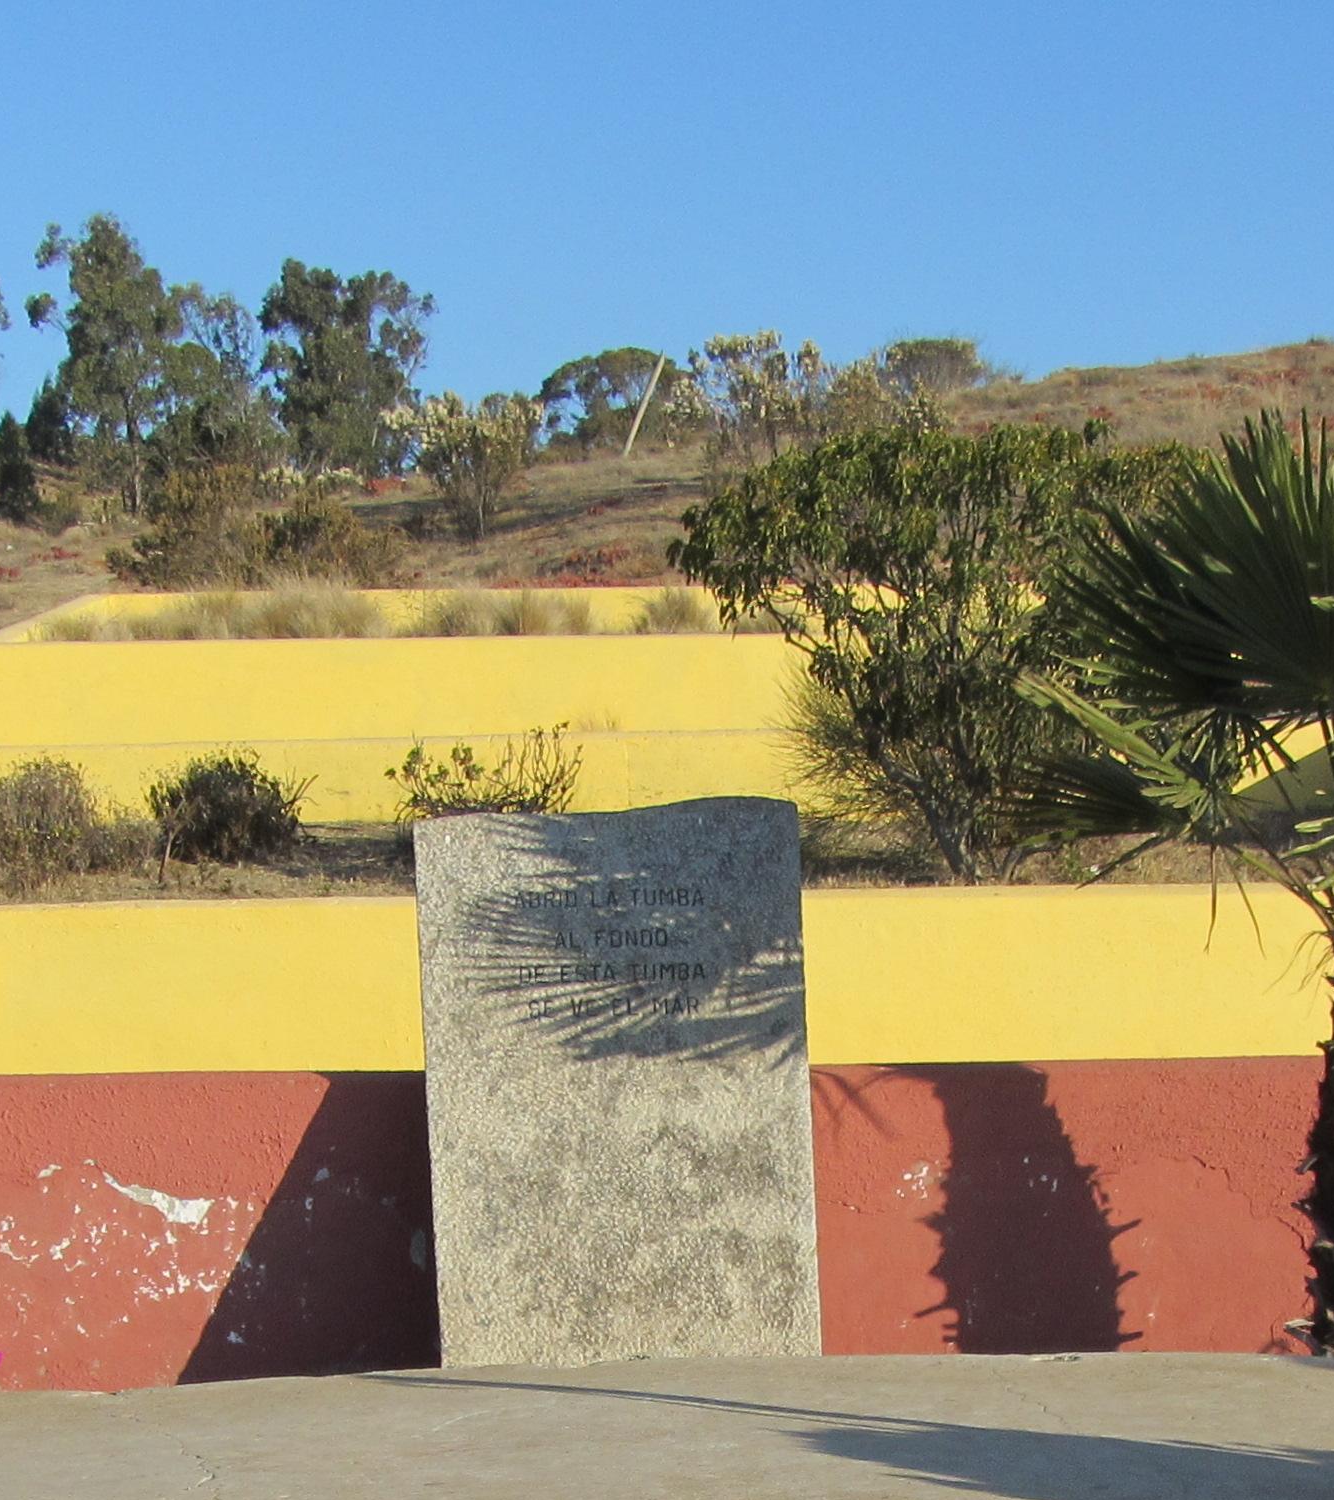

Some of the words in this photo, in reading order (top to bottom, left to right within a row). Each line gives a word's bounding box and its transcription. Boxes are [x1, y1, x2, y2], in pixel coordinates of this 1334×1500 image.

[516, 889, 578, 909] ABRID
[590, 889, 617, 908] LA
[630, 887, 705, 908] TUMBA
[554, 930, 581, 950] AL
[594, 927, 668, 949] FONDO
[518, 965, 547, 984] DE
[560, 963, 617, 983] ESTA
[629, 962, 706, 983] TUMBA
[527, 1000, 554, 1019] SE
[570, 998, 598, 1018] VE
[611, 997, 639, 1017] EL
[651, 996, 701, 1015] MAR
